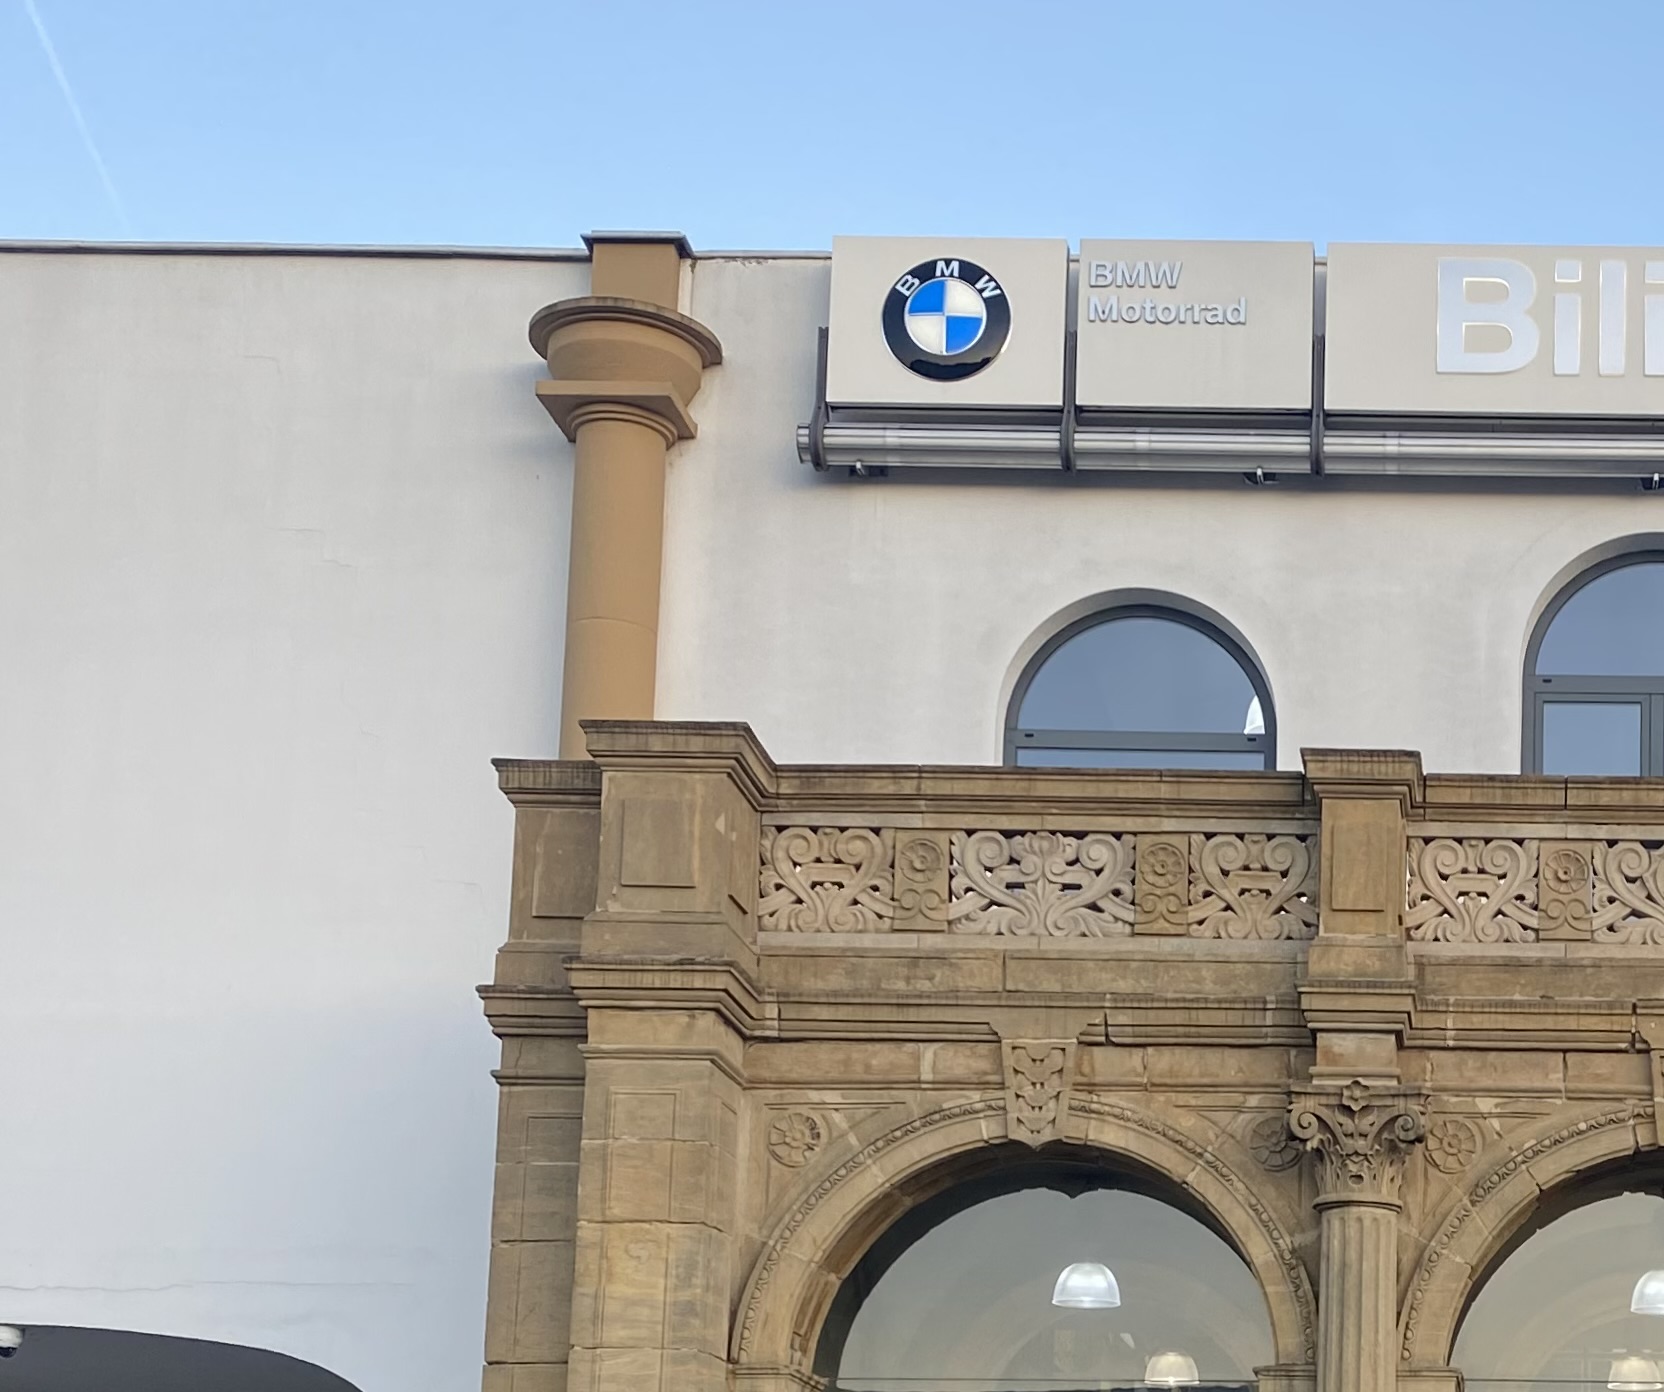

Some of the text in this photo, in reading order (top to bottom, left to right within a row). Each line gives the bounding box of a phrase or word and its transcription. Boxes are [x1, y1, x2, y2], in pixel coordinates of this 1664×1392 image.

[895, 260, 1002, 299] BMW
[1088, 260, 1183, 289] BMW
[1088, 295, 1248, 325] Motorrad
